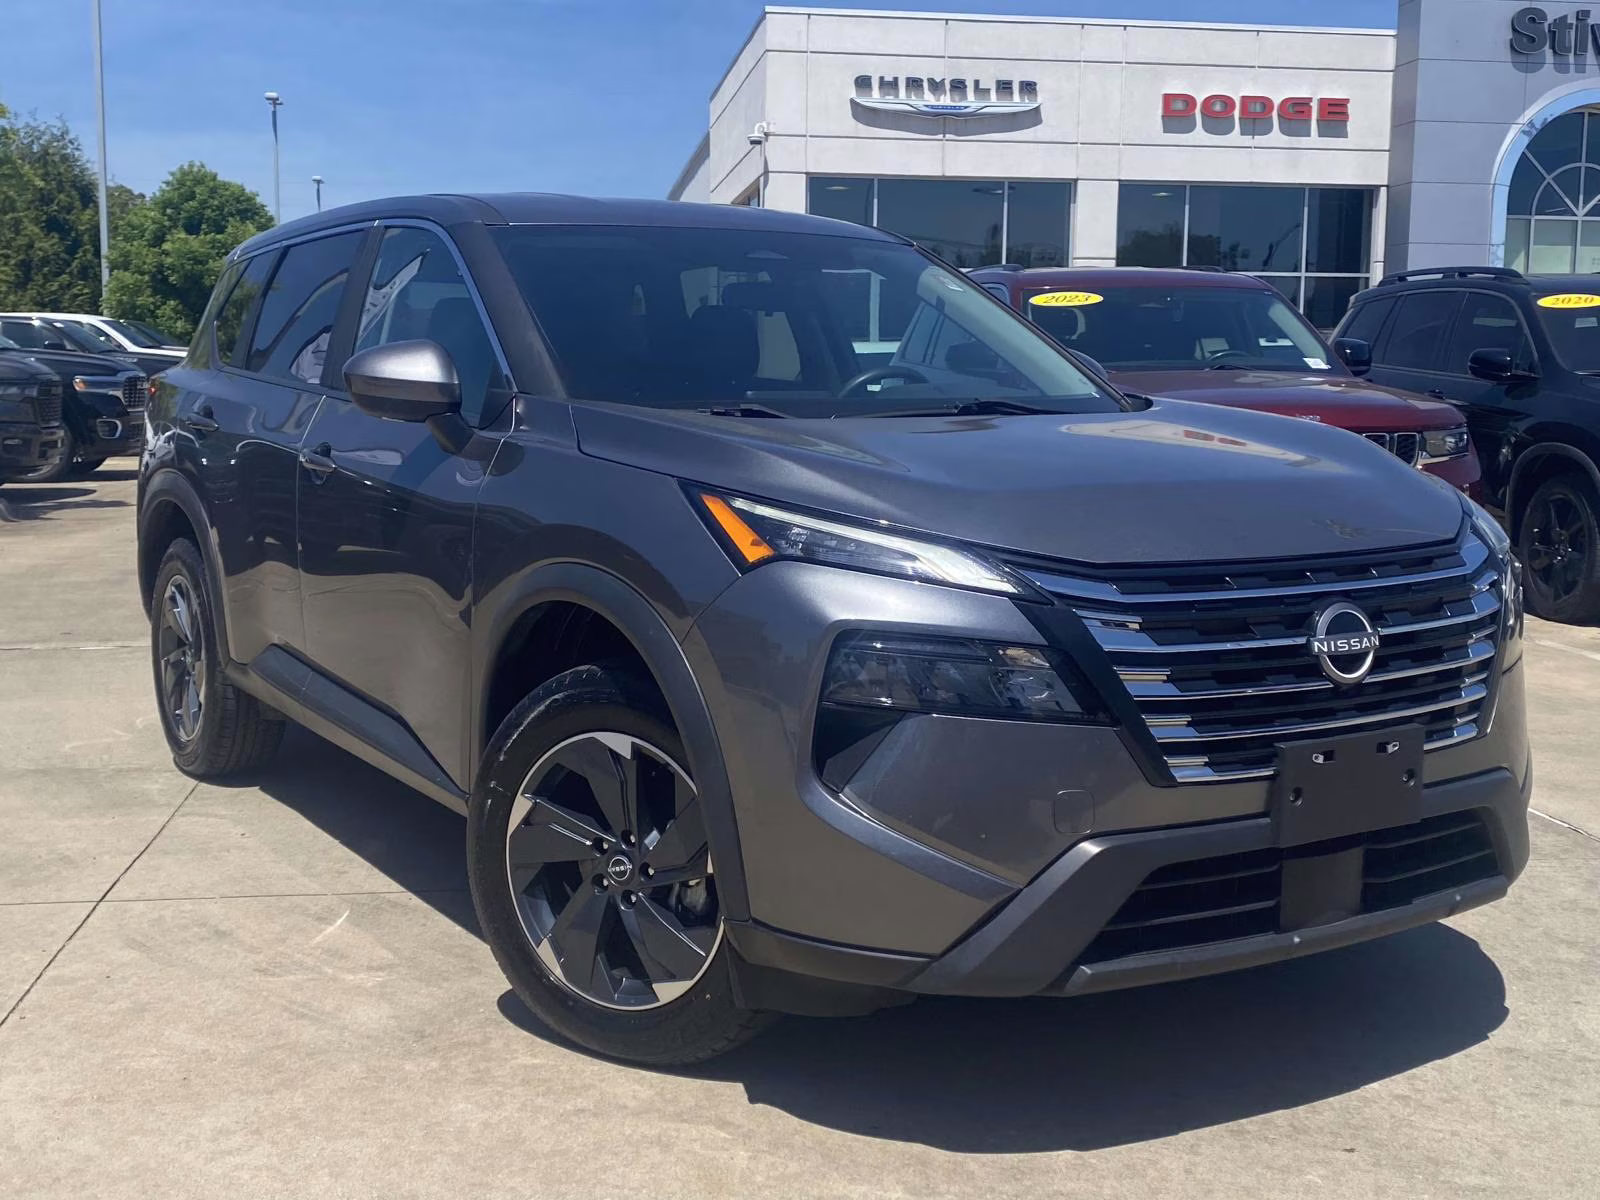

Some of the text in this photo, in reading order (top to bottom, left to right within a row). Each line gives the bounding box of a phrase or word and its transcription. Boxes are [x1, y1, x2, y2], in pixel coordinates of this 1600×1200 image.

[854, 75, 1038, 93] CHRYSLER
[1162, 93, 1350, 121] DODGE
[1043, 294, 1091, 304] 2023
[1552, 296, 1594, 305] 2020
[1313, 635, 1380, 653] NISSAN
